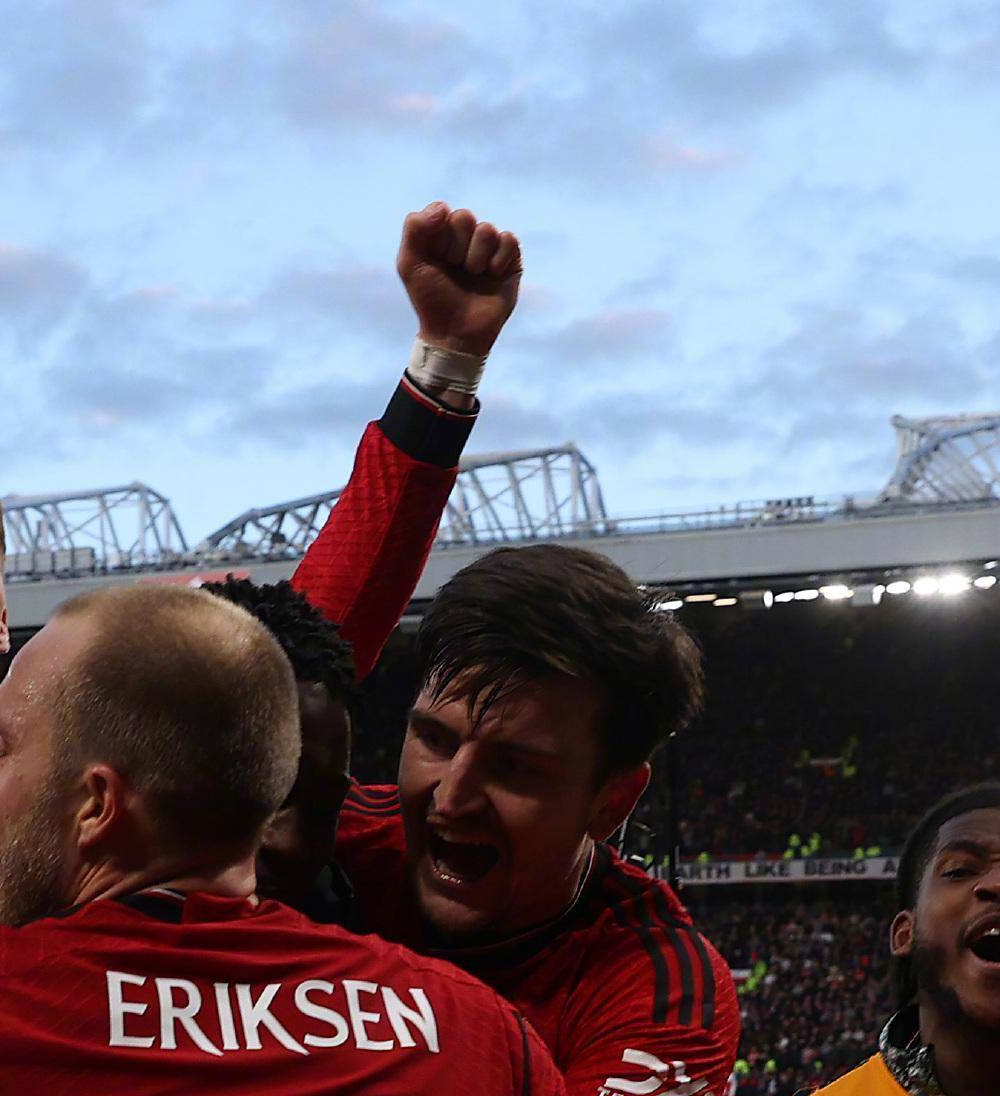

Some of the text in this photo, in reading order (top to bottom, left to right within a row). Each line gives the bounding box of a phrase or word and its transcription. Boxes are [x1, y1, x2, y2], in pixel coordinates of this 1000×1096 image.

[664, 864, 730, 880] ARTH
[745, 860, 790, 878] LIKE
[804, 859, 869, 876] BEING
[106, 970, 440, 1056] ERIKSEN
